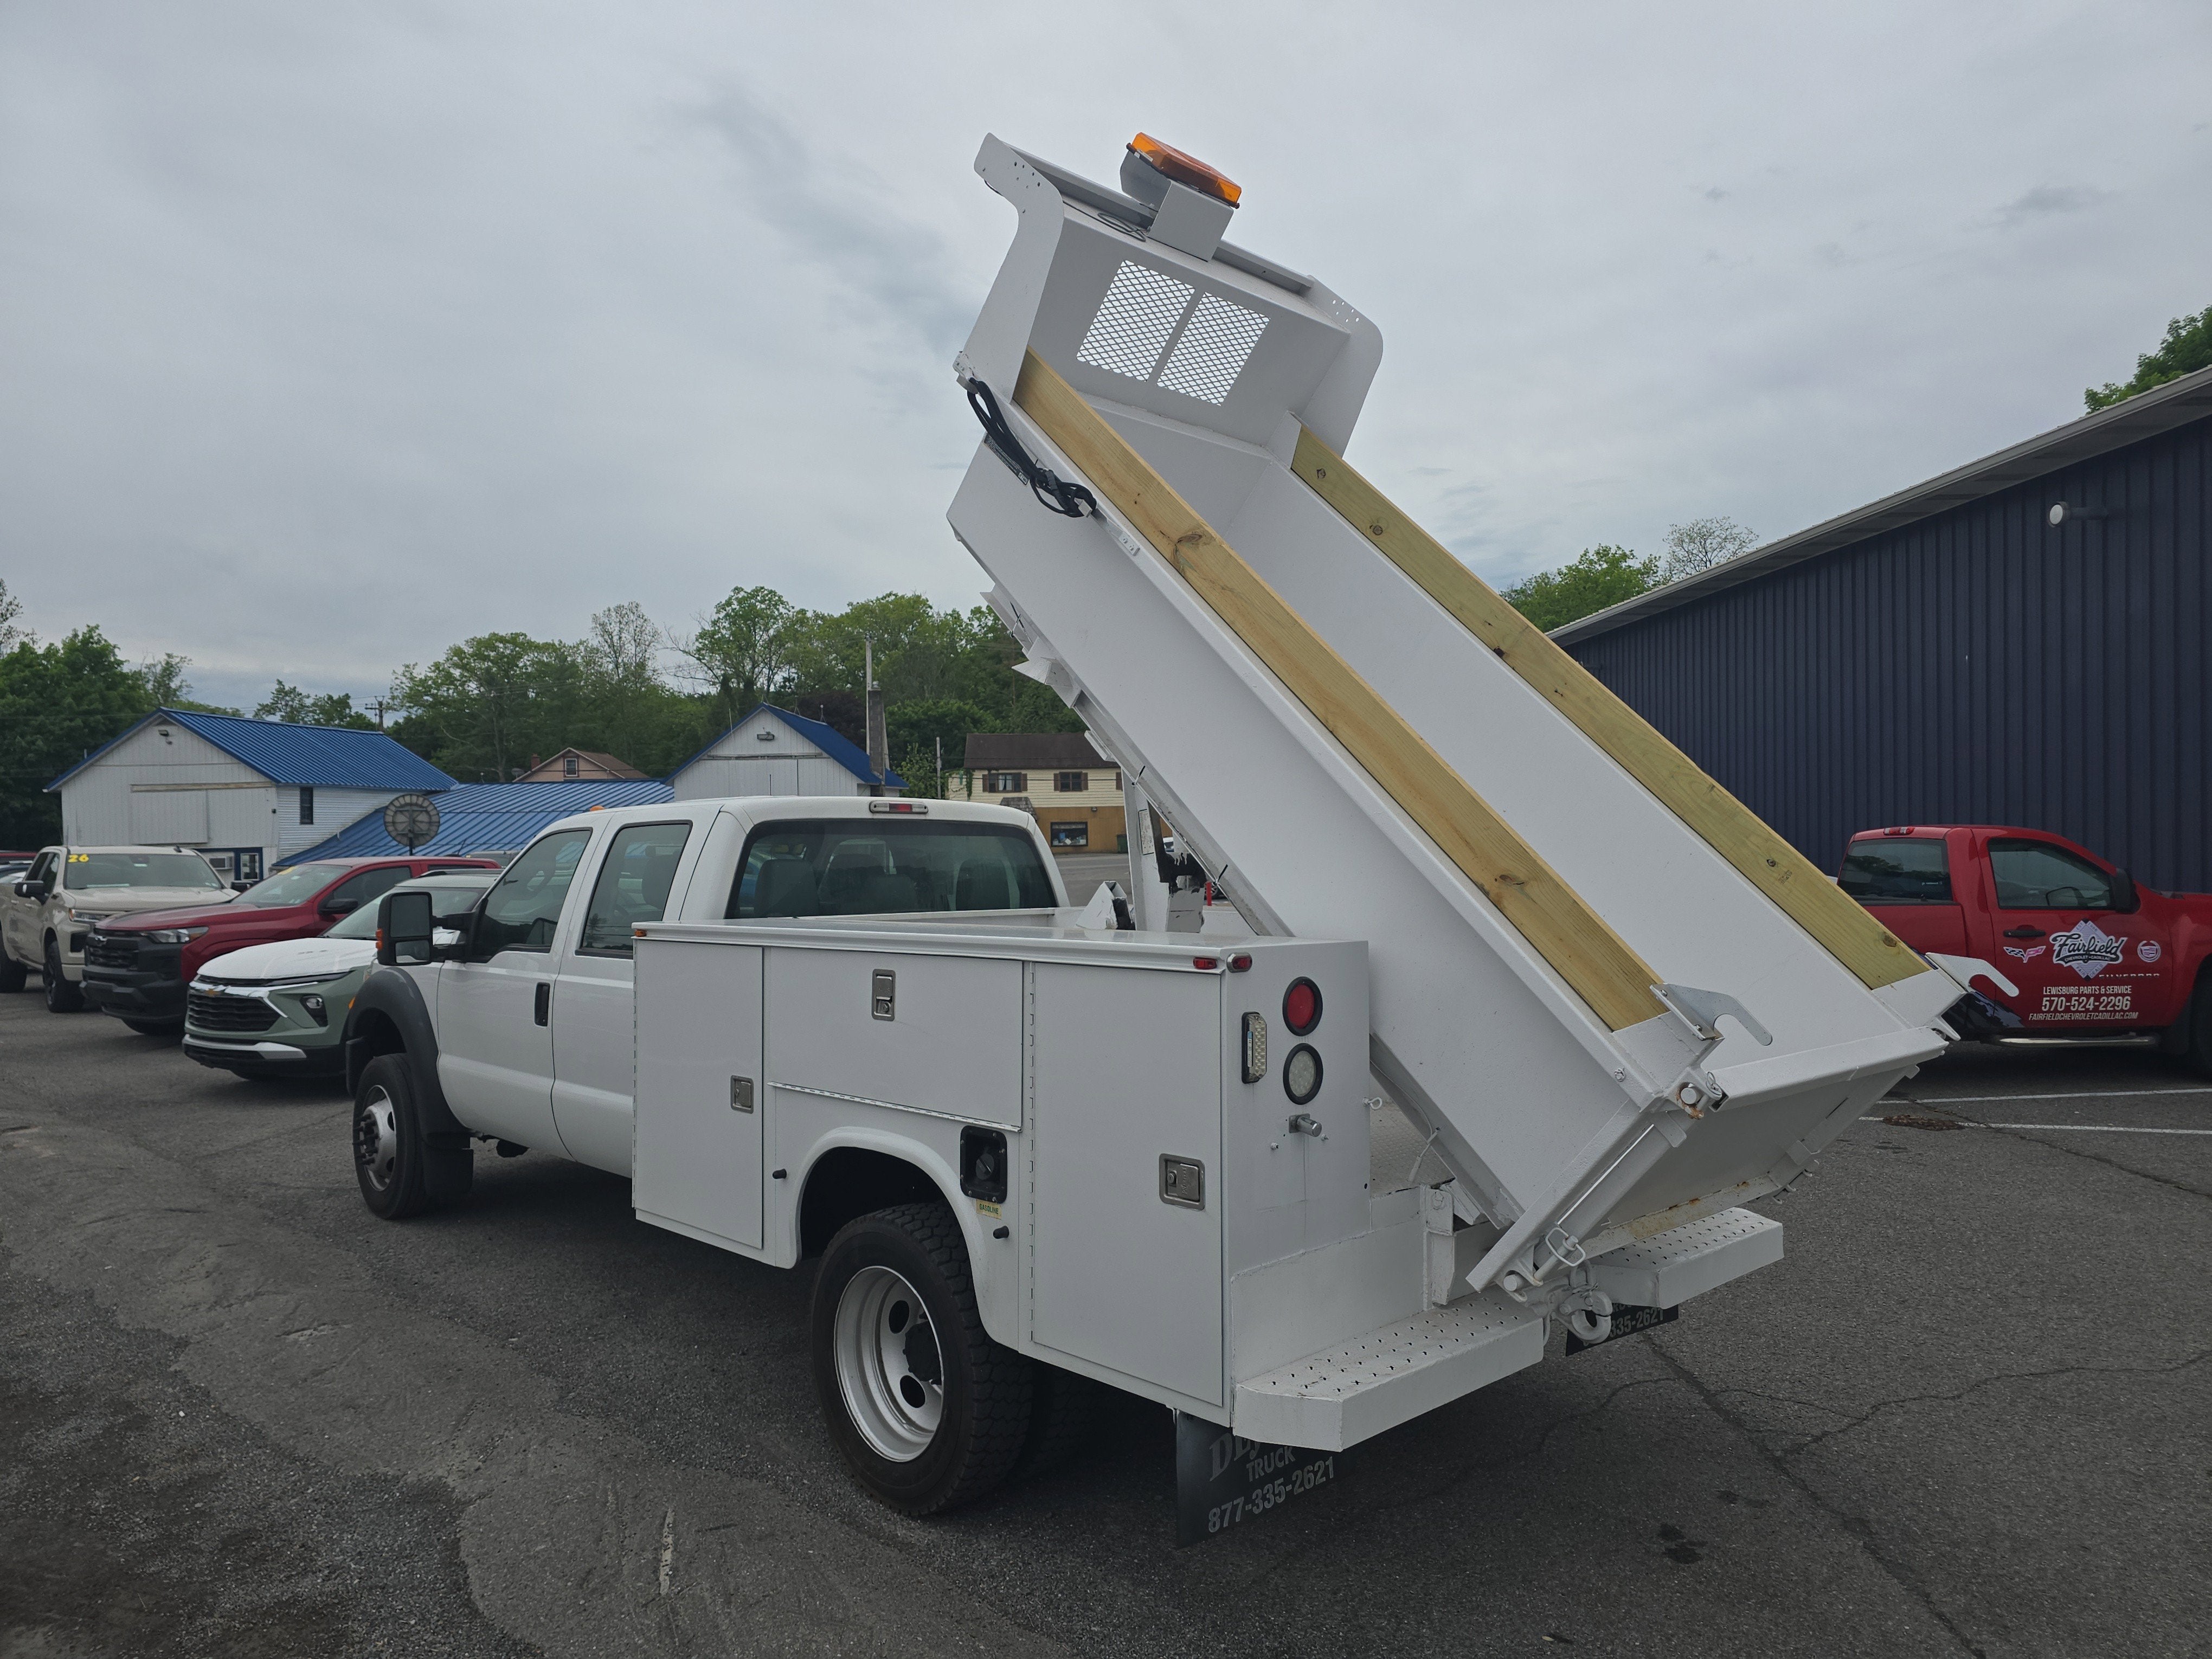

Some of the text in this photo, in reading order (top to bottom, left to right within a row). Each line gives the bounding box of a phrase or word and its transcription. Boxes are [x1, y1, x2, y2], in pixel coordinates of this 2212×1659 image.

[68, 854, 89, 863] 26
[2051, 933, 2125, 959] Fairfield
[2043, 985, 2132, 995] LEWISBURG PARTS & SERVICE
[2041, 996, 2131, 1012] 570-524-2296
[2028, 1012, 2139, 1020] FAIRFIELDCHEVROLETCADILLAC.COM
[979, 1203, 999, 1214] GASOLINE
[1609, 1307, 1663, 1338] 335-2621
[1246, 1446, 1296, 1482] TRUCK
[1208, 1456, 1334, 1533] 877-335-2621
